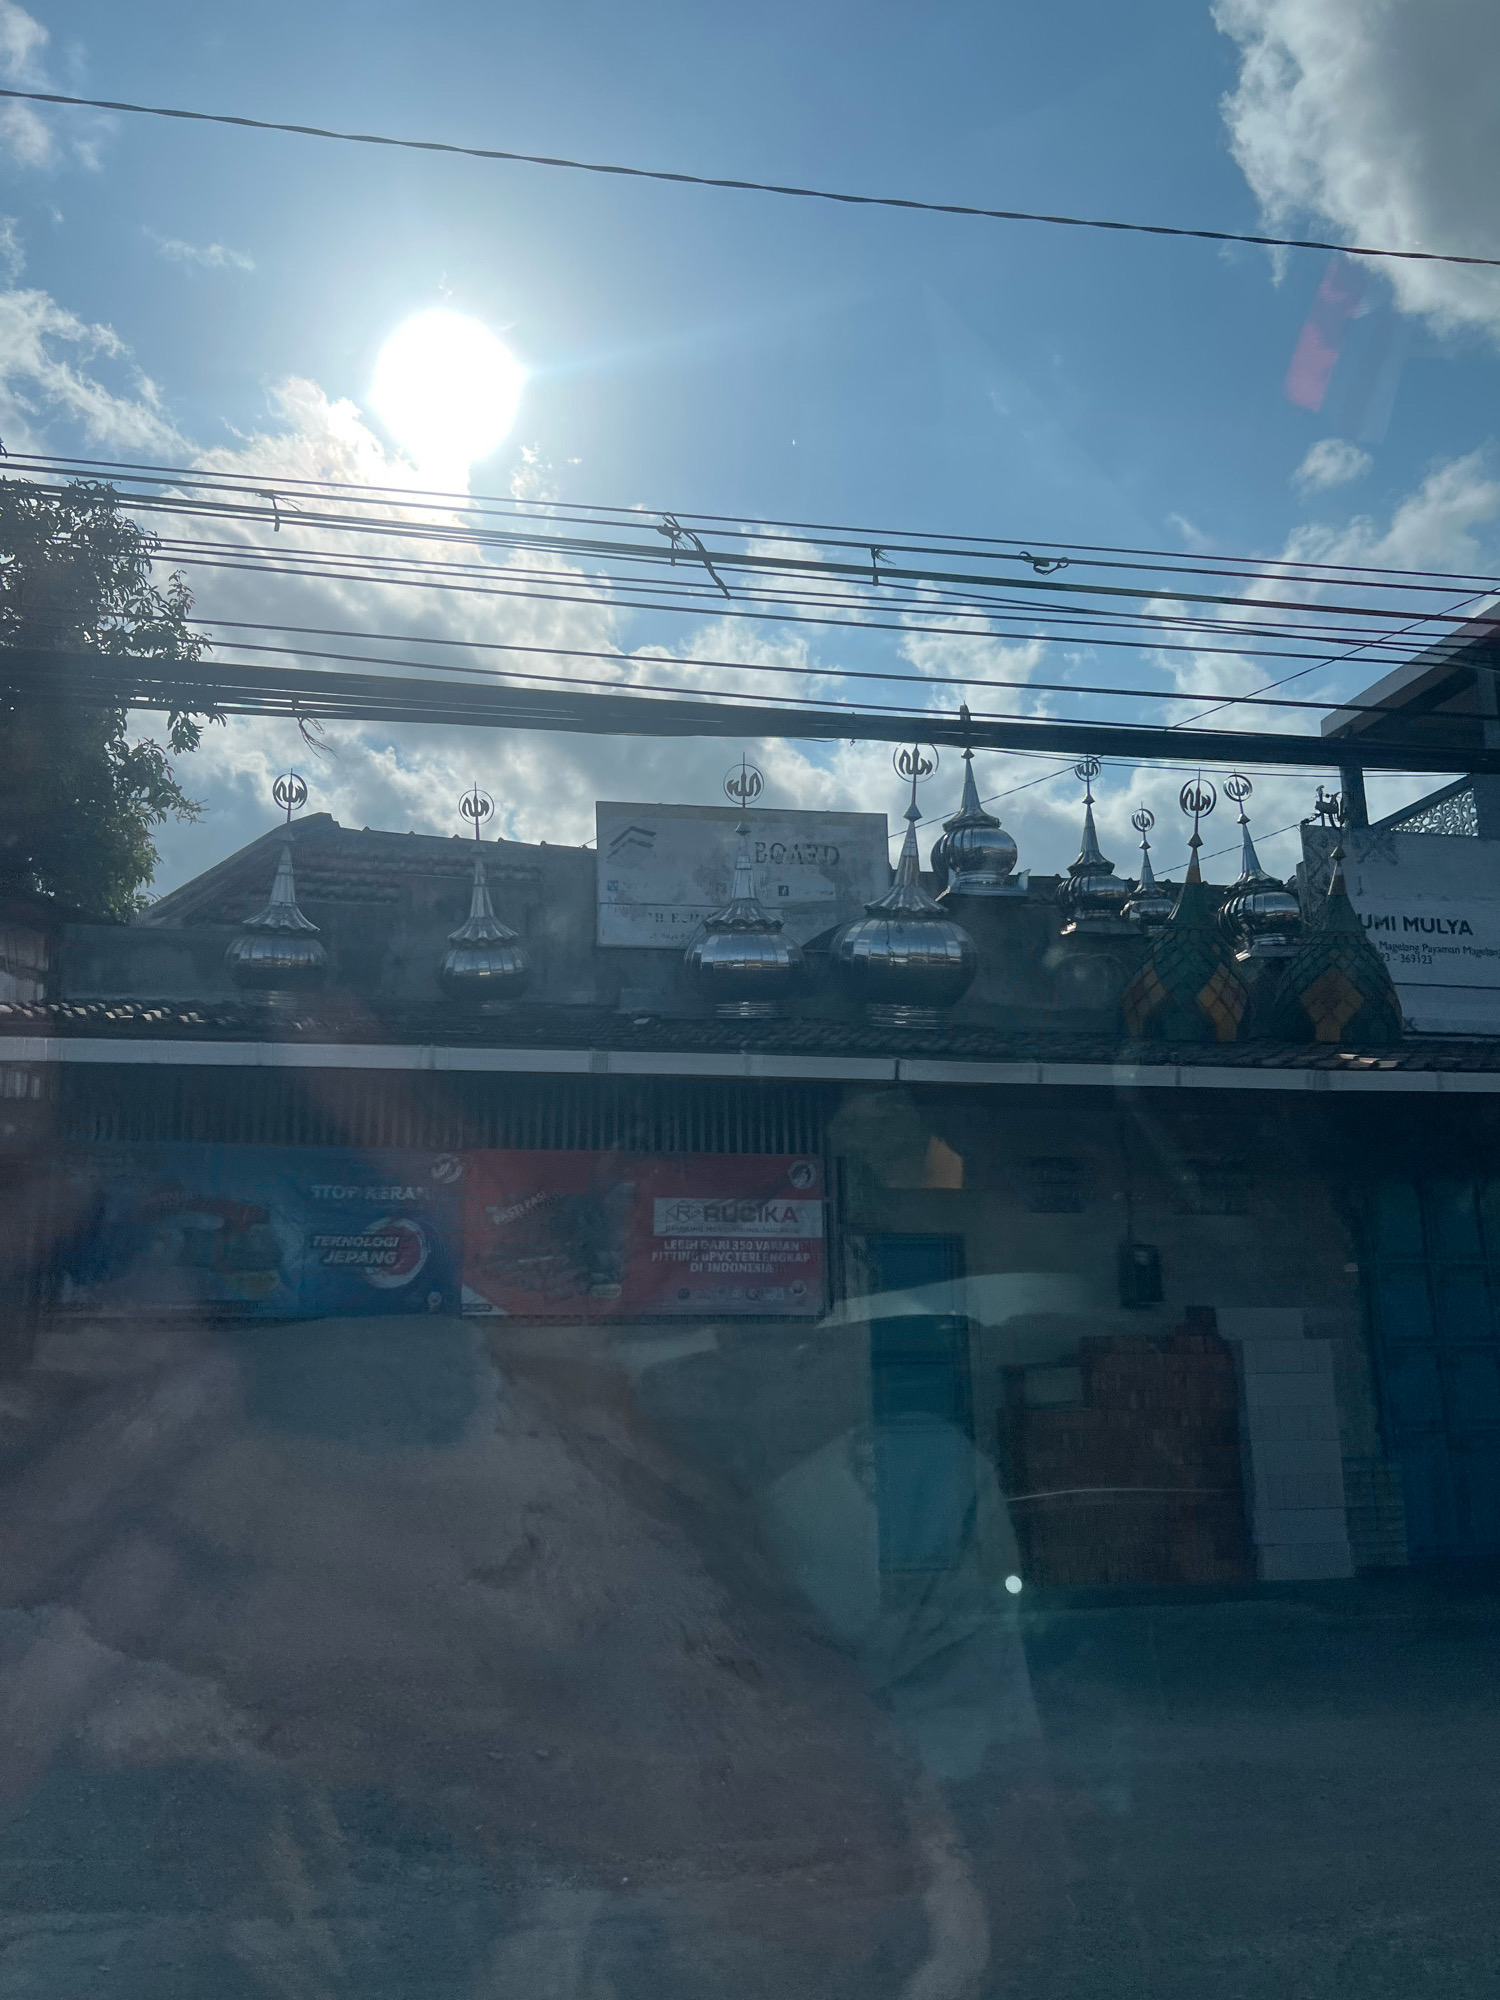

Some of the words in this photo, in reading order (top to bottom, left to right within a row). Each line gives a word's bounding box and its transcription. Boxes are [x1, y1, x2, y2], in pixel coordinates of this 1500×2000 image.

[1402, 915, 1474, 936] MULYA
[1421, 942, 1461, 957] Payaman
[311, 1184, 358, 1200] STOP
[703, 1204, 799, 1223] RUCIKA
[312, 1235, 400, 1248] TEKNOLOGI
[732, 1240, 753, 1251] 350
[755, 1240, 801, 1252] VARIAN
[322, 1250, 398, 1265] JEPANG
[690, 1262, 703, 1274] DI
